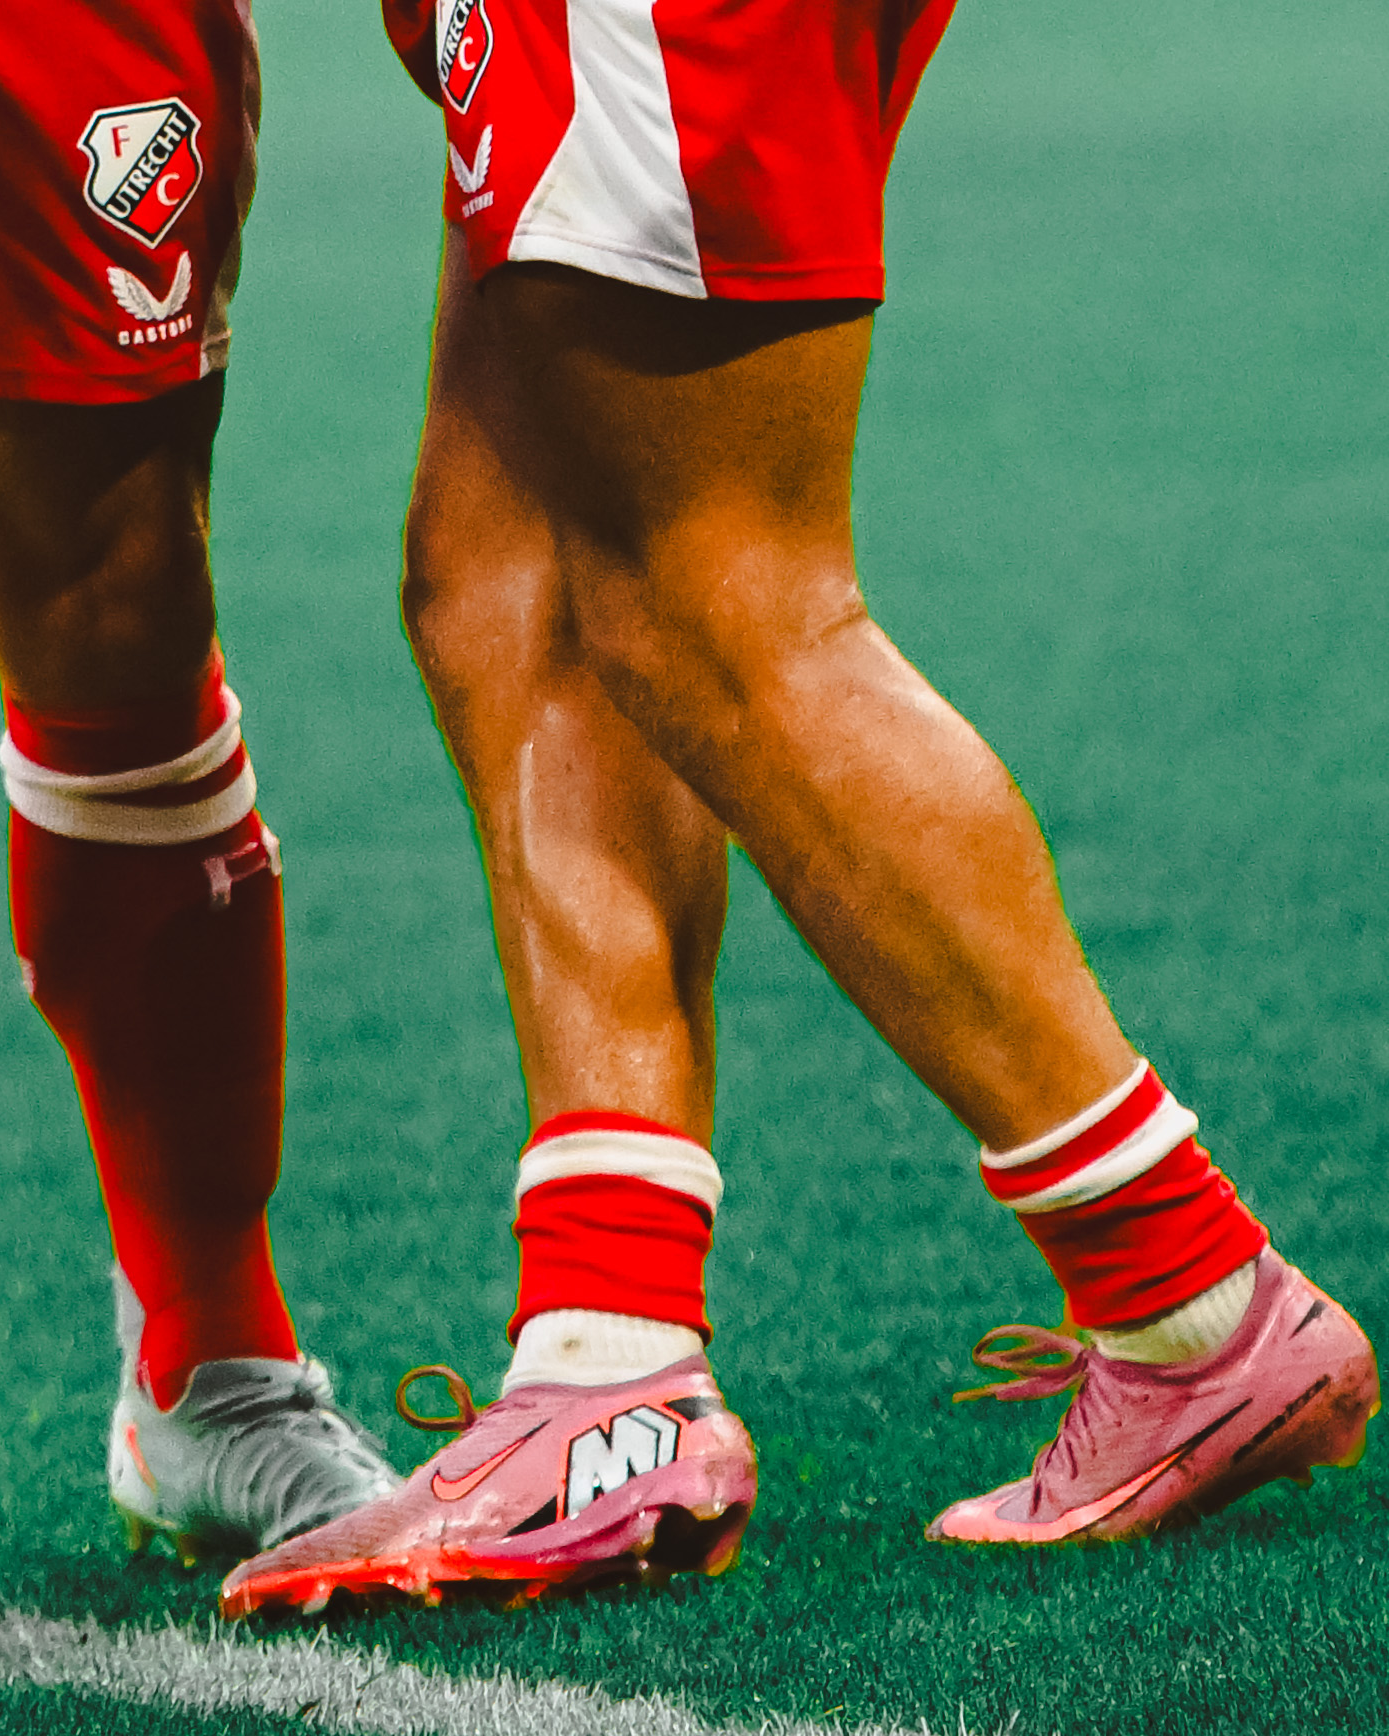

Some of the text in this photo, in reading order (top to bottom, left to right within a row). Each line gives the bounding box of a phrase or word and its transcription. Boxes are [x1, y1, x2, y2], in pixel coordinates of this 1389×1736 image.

[112, 125, 129, 157] F
[106, 111, 188, 219] UTRECHT
[156, 172, 180, 206] C
